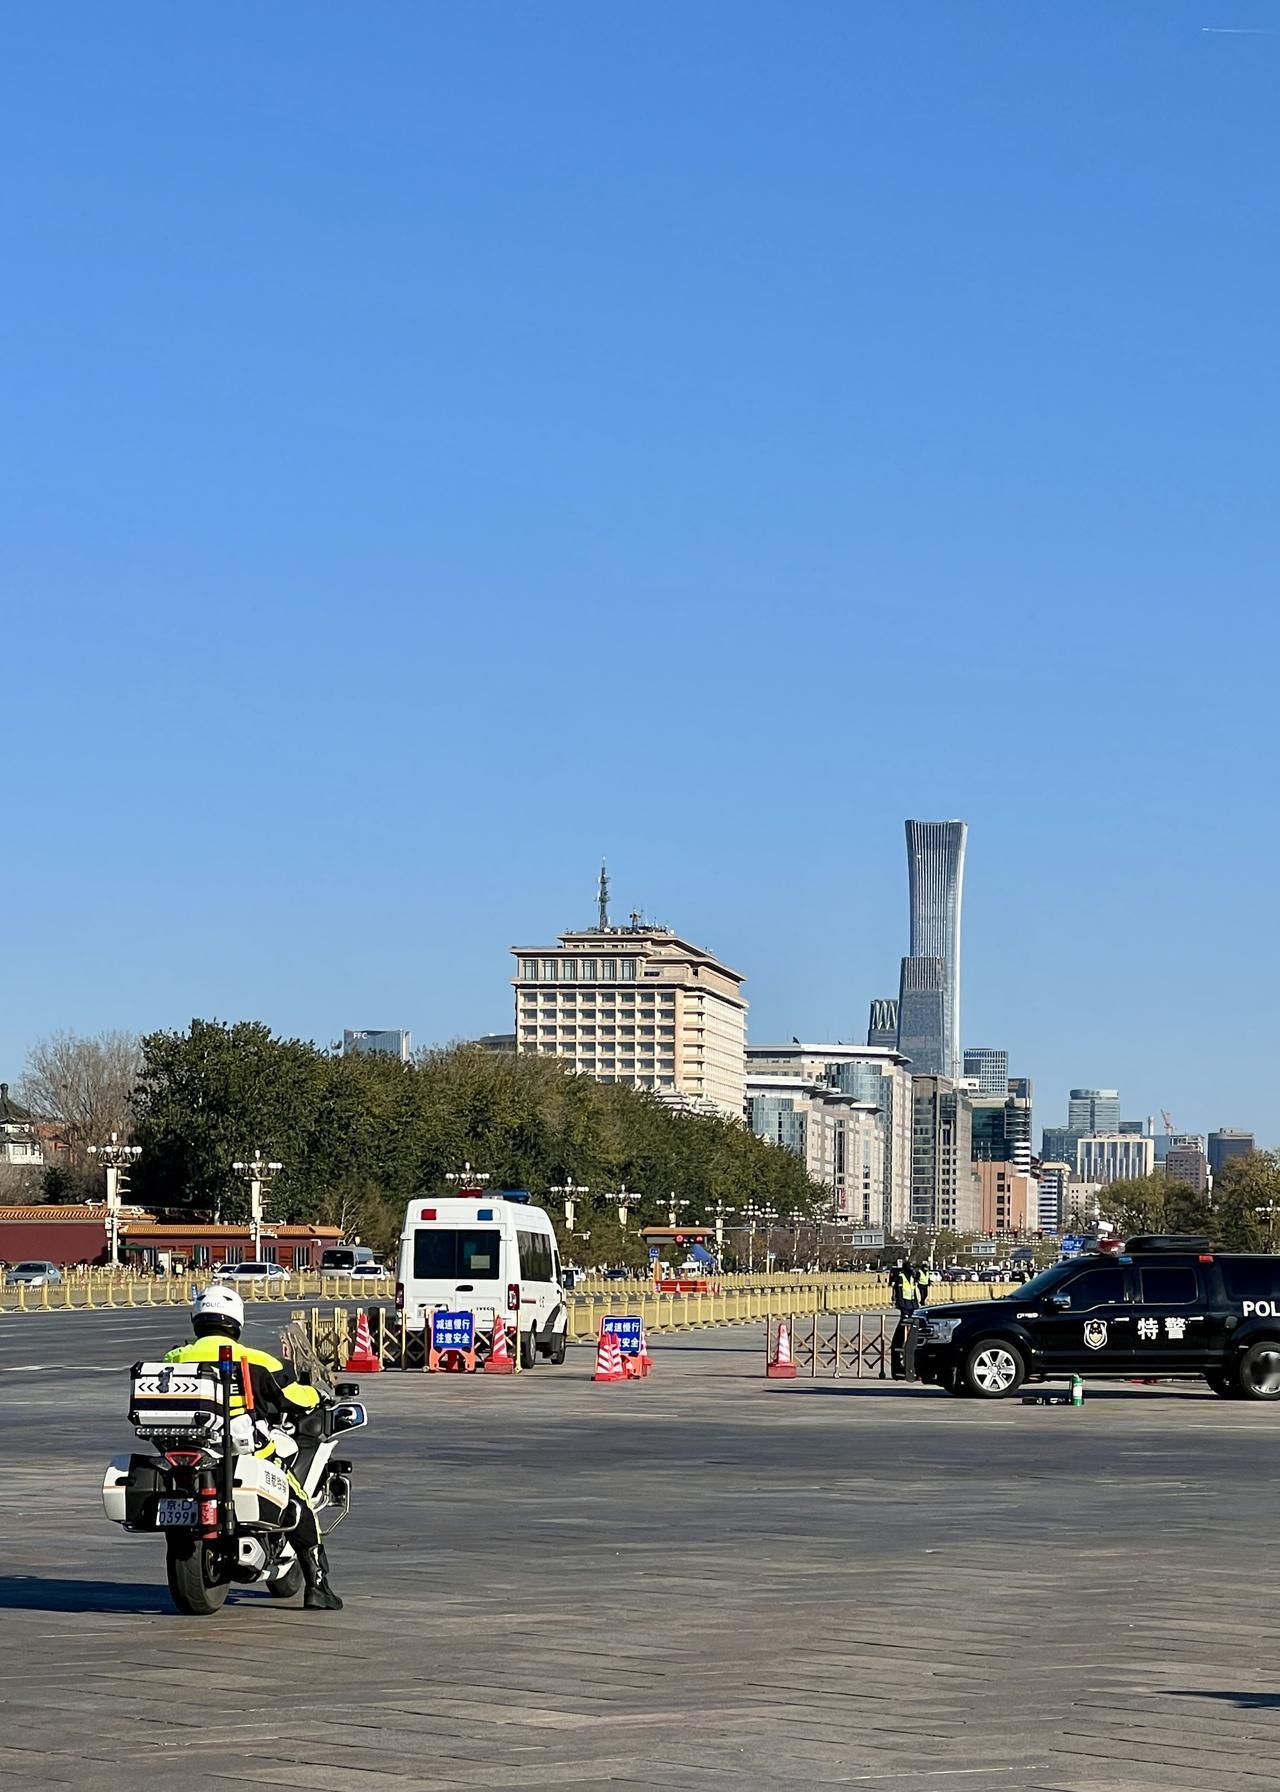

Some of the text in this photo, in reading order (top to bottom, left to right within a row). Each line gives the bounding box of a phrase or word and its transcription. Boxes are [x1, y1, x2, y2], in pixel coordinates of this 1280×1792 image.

[436, 1319, 470, 1330] 减速慢行
[1137, 1317, 1186, 1340] 特警
[436, 1332, 470, 1344] 注意安全
[159, 1511, 197, 1524] 0399
